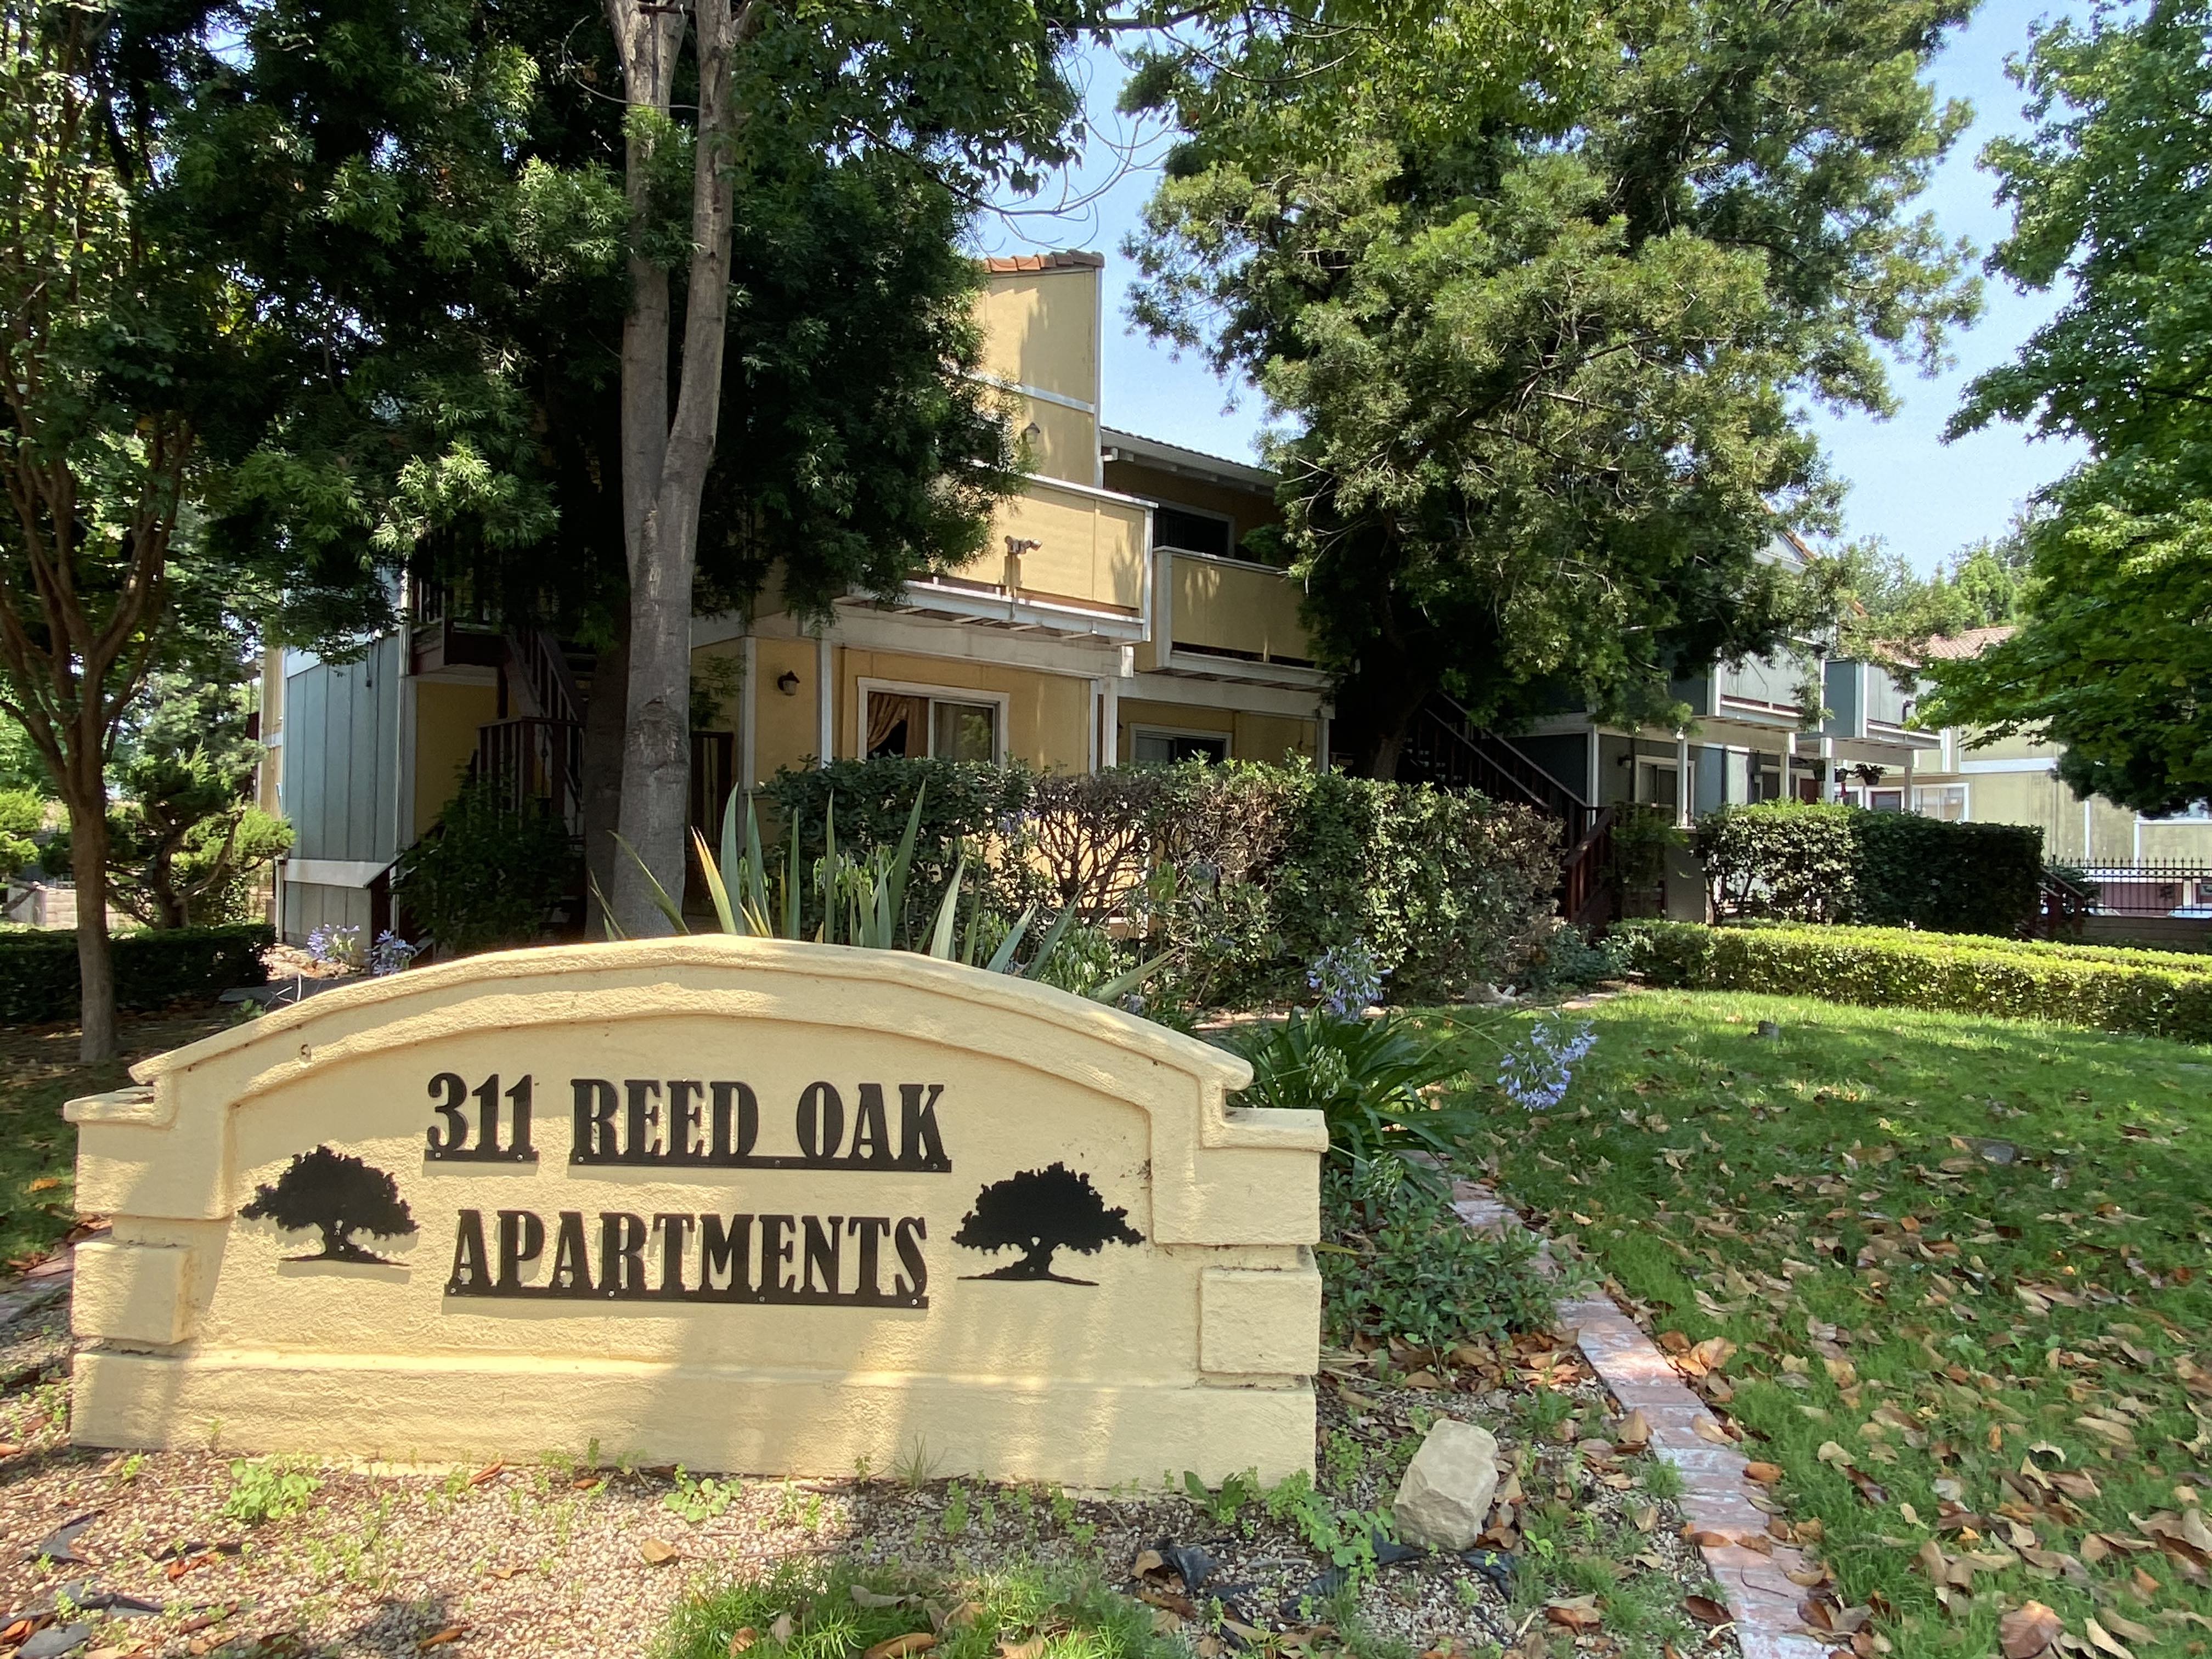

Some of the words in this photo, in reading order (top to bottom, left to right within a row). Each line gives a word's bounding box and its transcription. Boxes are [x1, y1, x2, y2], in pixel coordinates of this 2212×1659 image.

[426, 1072, 536, 1156] 311
[570, 1078, 759, 1161] REED
[796, 1081, 949, 1165] OAK
[447, 1209, 928, 1300] APARTMENTS
